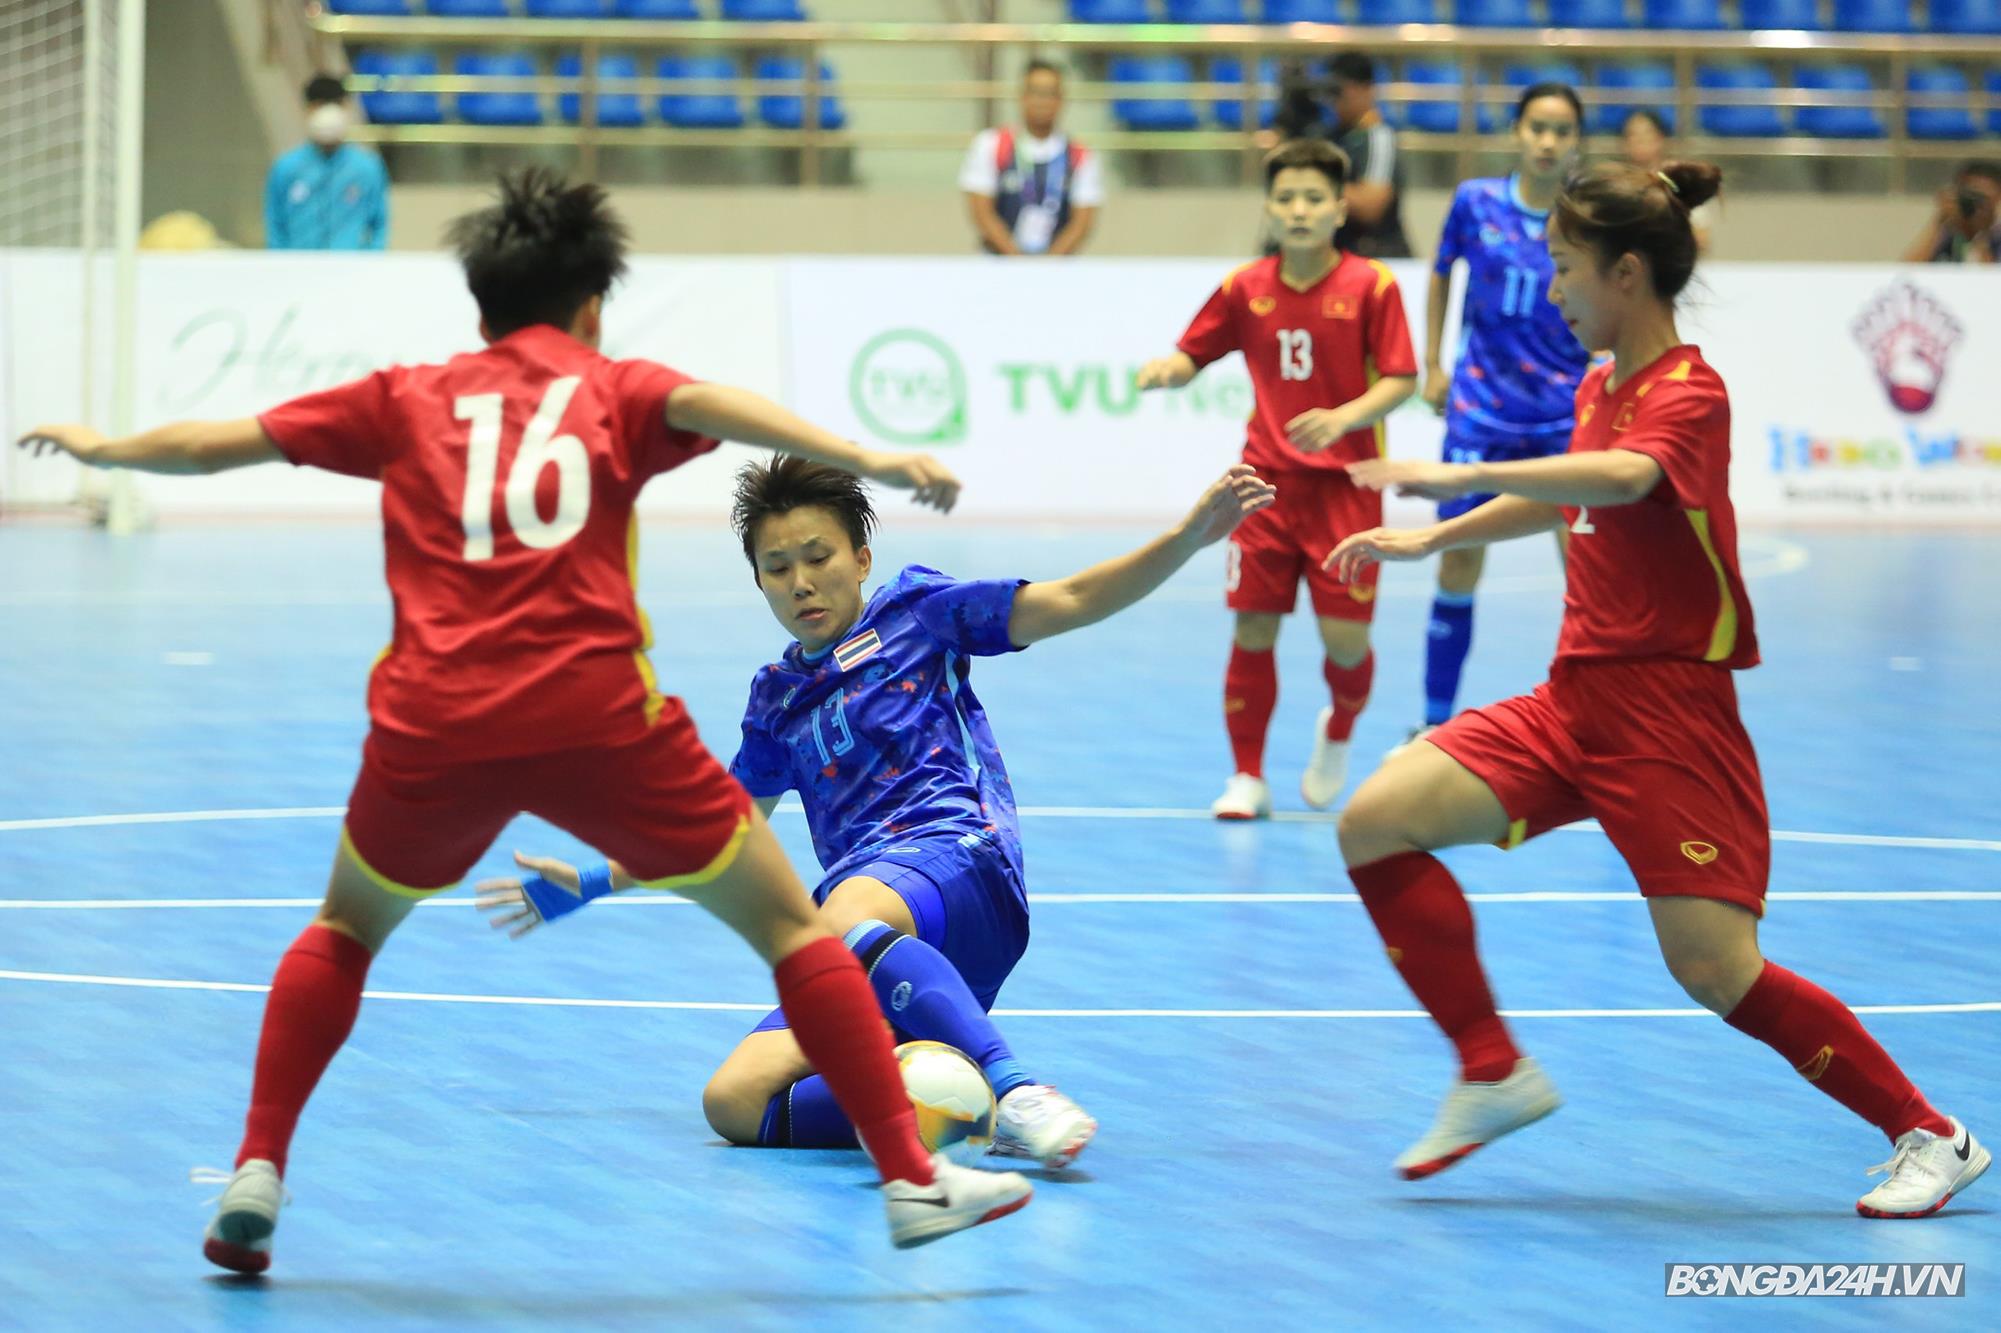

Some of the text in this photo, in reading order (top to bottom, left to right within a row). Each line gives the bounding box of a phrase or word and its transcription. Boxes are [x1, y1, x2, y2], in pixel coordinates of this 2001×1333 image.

[1502, 265, 1538, 318] 11
[1276, 328, 1314, 381] 13
[997, 361, 1140, 416] TVU
[454, 375, 591, 562] 16
[811, 687, 855, 766] 13
